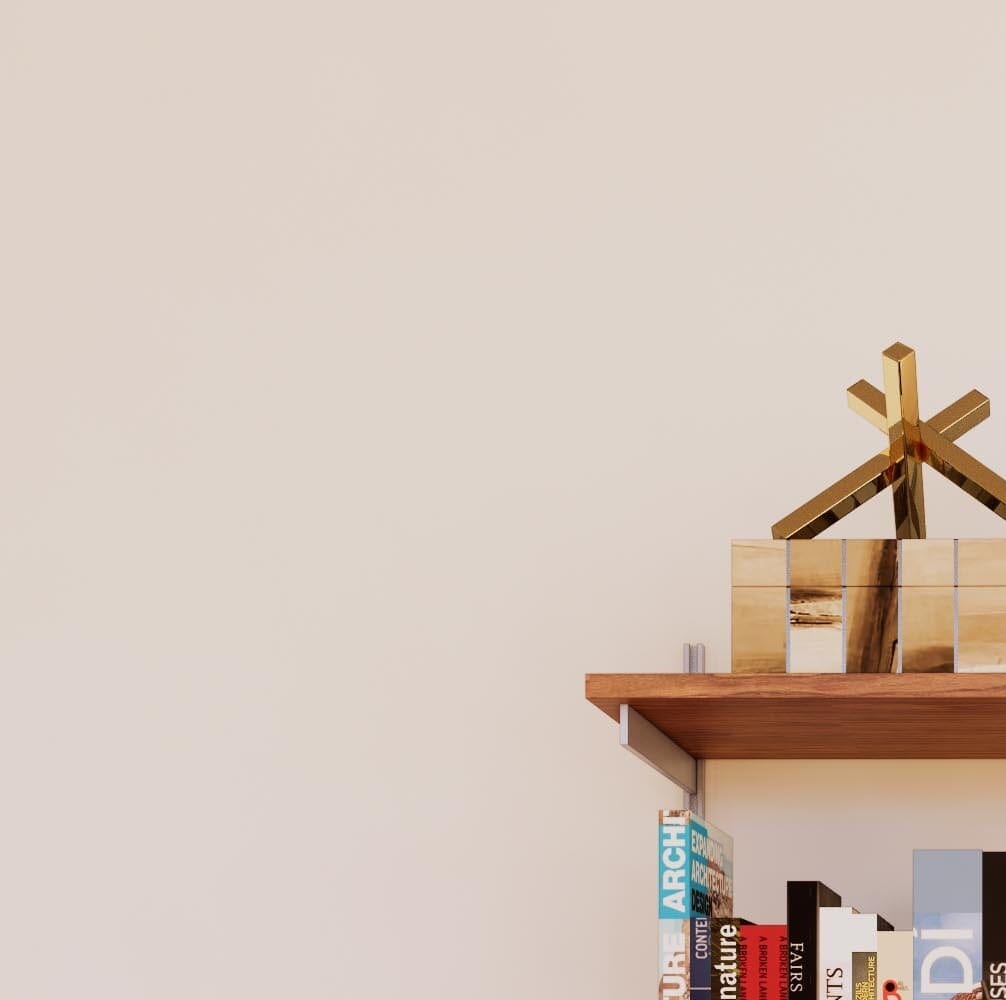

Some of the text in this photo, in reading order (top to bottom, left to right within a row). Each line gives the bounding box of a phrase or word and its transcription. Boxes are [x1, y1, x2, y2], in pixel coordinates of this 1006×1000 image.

[758, 944, 768, 979] BROKEN
[777, 944, 787, 979] BROKEN
[789, 942, 804, 993] FAIRS
